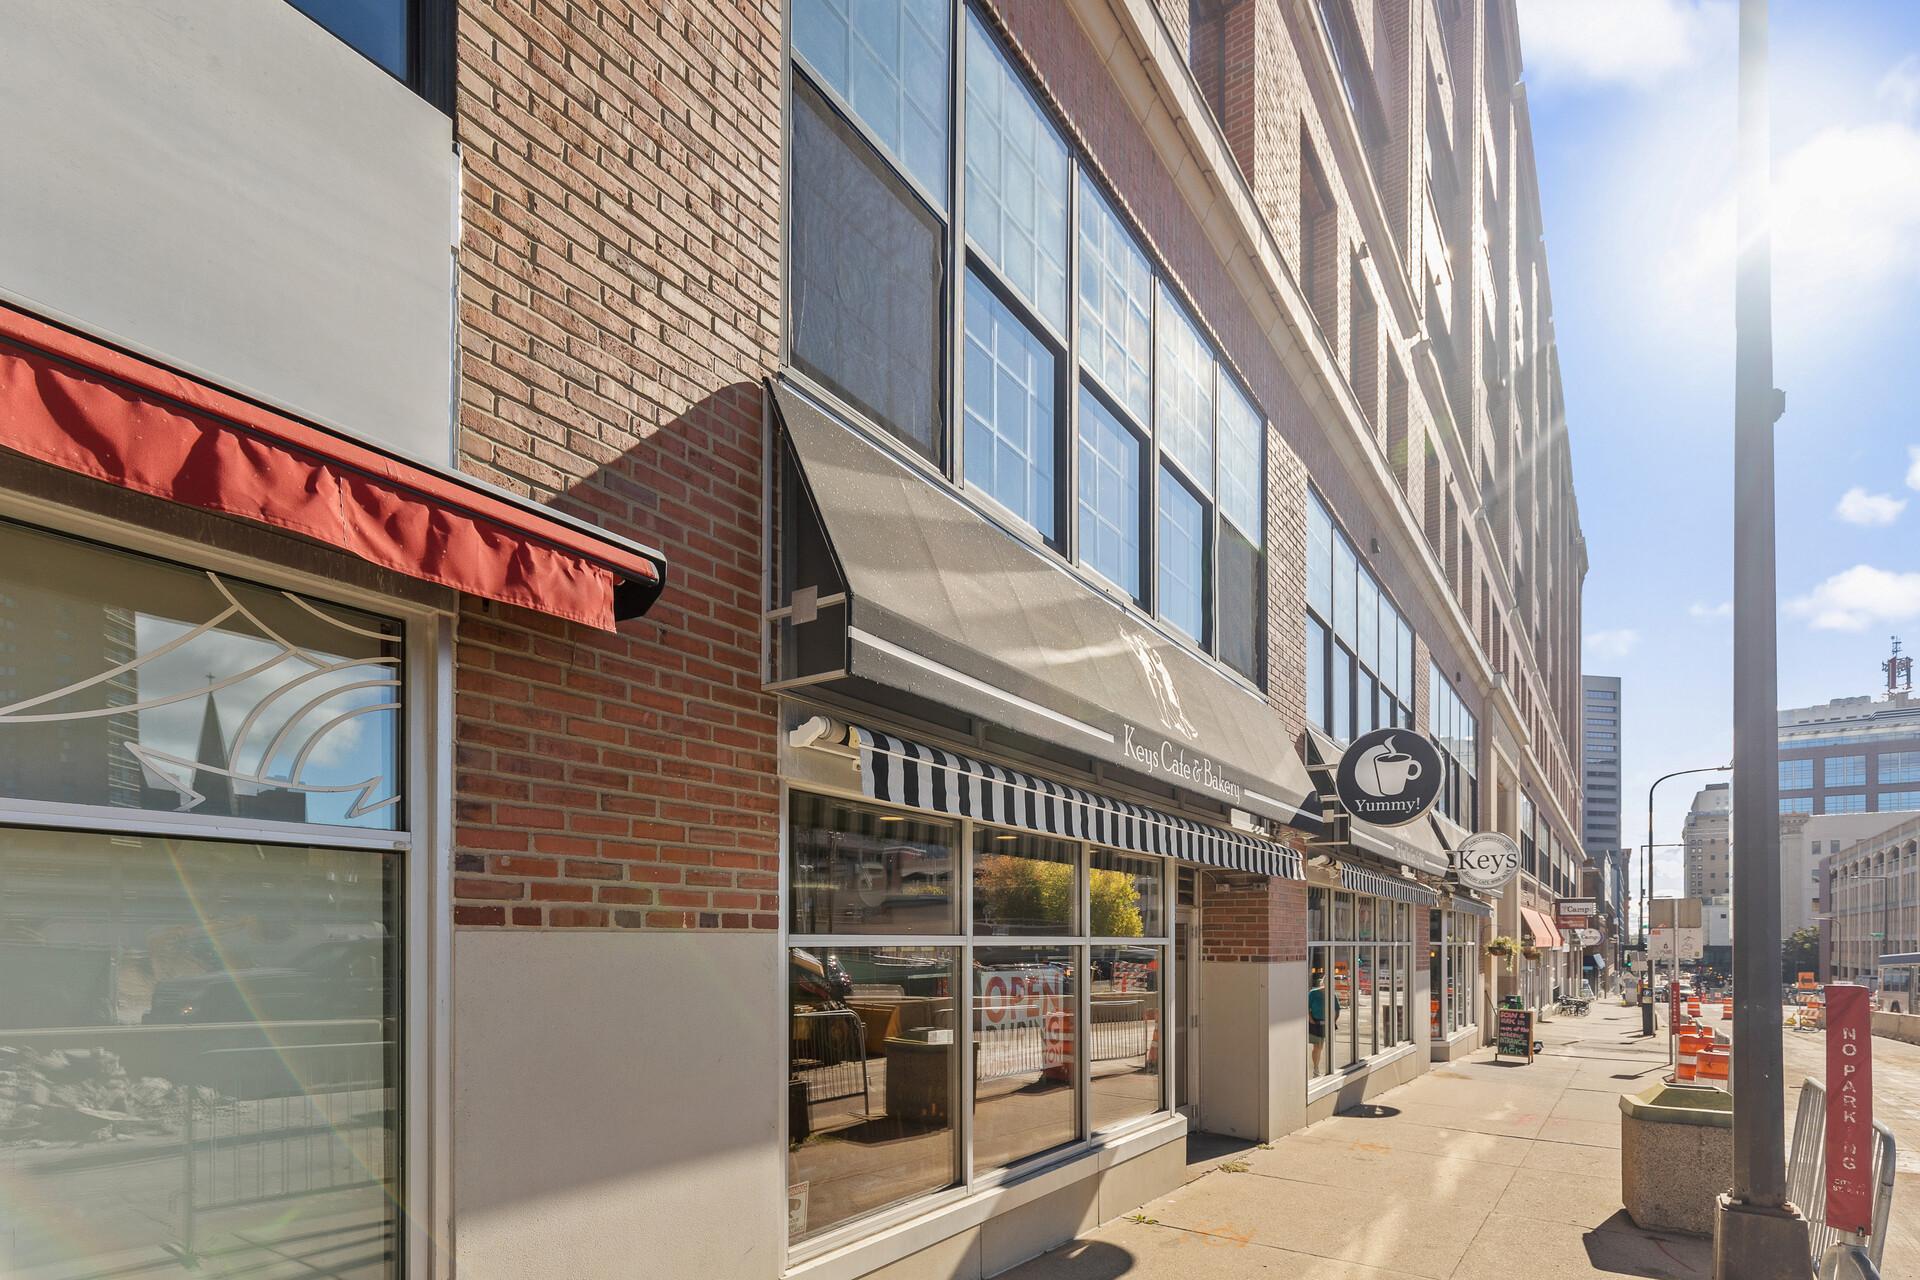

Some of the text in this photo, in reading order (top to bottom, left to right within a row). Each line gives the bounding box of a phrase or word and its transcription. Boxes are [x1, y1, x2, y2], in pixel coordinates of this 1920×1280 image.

[1123, 723, 1240, 804] Keys Cafe & Bakery
[1355, 797, 1420, 813] Yummy!
[1457, 850, 1517, 874] Keys
[1567, 905, 1590, 913] Camp
[985, 972, 1060, 1023] OPEN
[1842, 1028, 1857, 1056] NO
[1842, 1065, 1857, 1170] PARKNG
